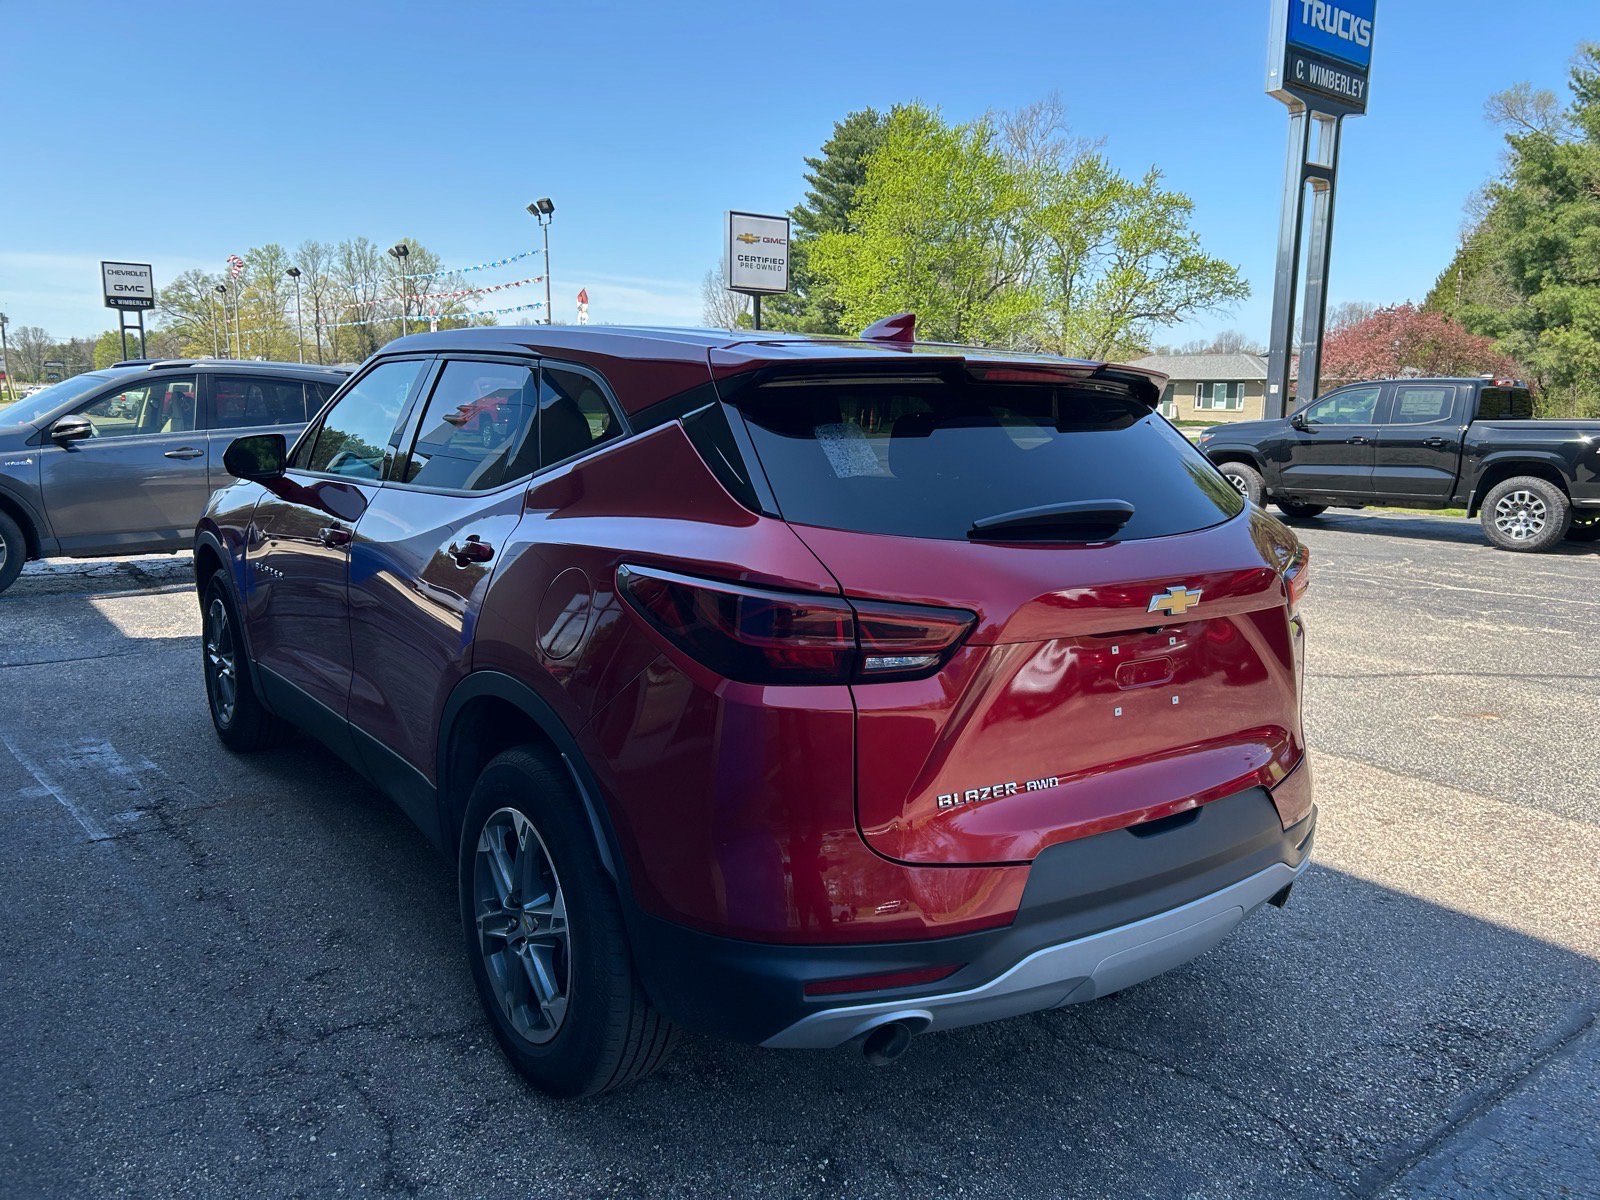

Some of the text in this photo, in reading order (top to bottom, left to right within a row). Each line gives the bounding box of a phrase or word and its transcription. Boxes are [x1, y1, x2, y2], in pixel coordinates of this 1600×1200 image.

[1301, 0, 1372, 47] TRUCKS
[1296, 59, 1365, 98] C. WIMBERLEY
[762, 237, 786, 245] GMC
[737, 254, 785, 265] CERTIFIED
[740, 262, 782, 271] PRE-OWNED
[107, 269, 148, 277] CHEVROLET
[113, 284, 145, 292] GMC
[937, 776, 1059, 809] BLAZER AWD
